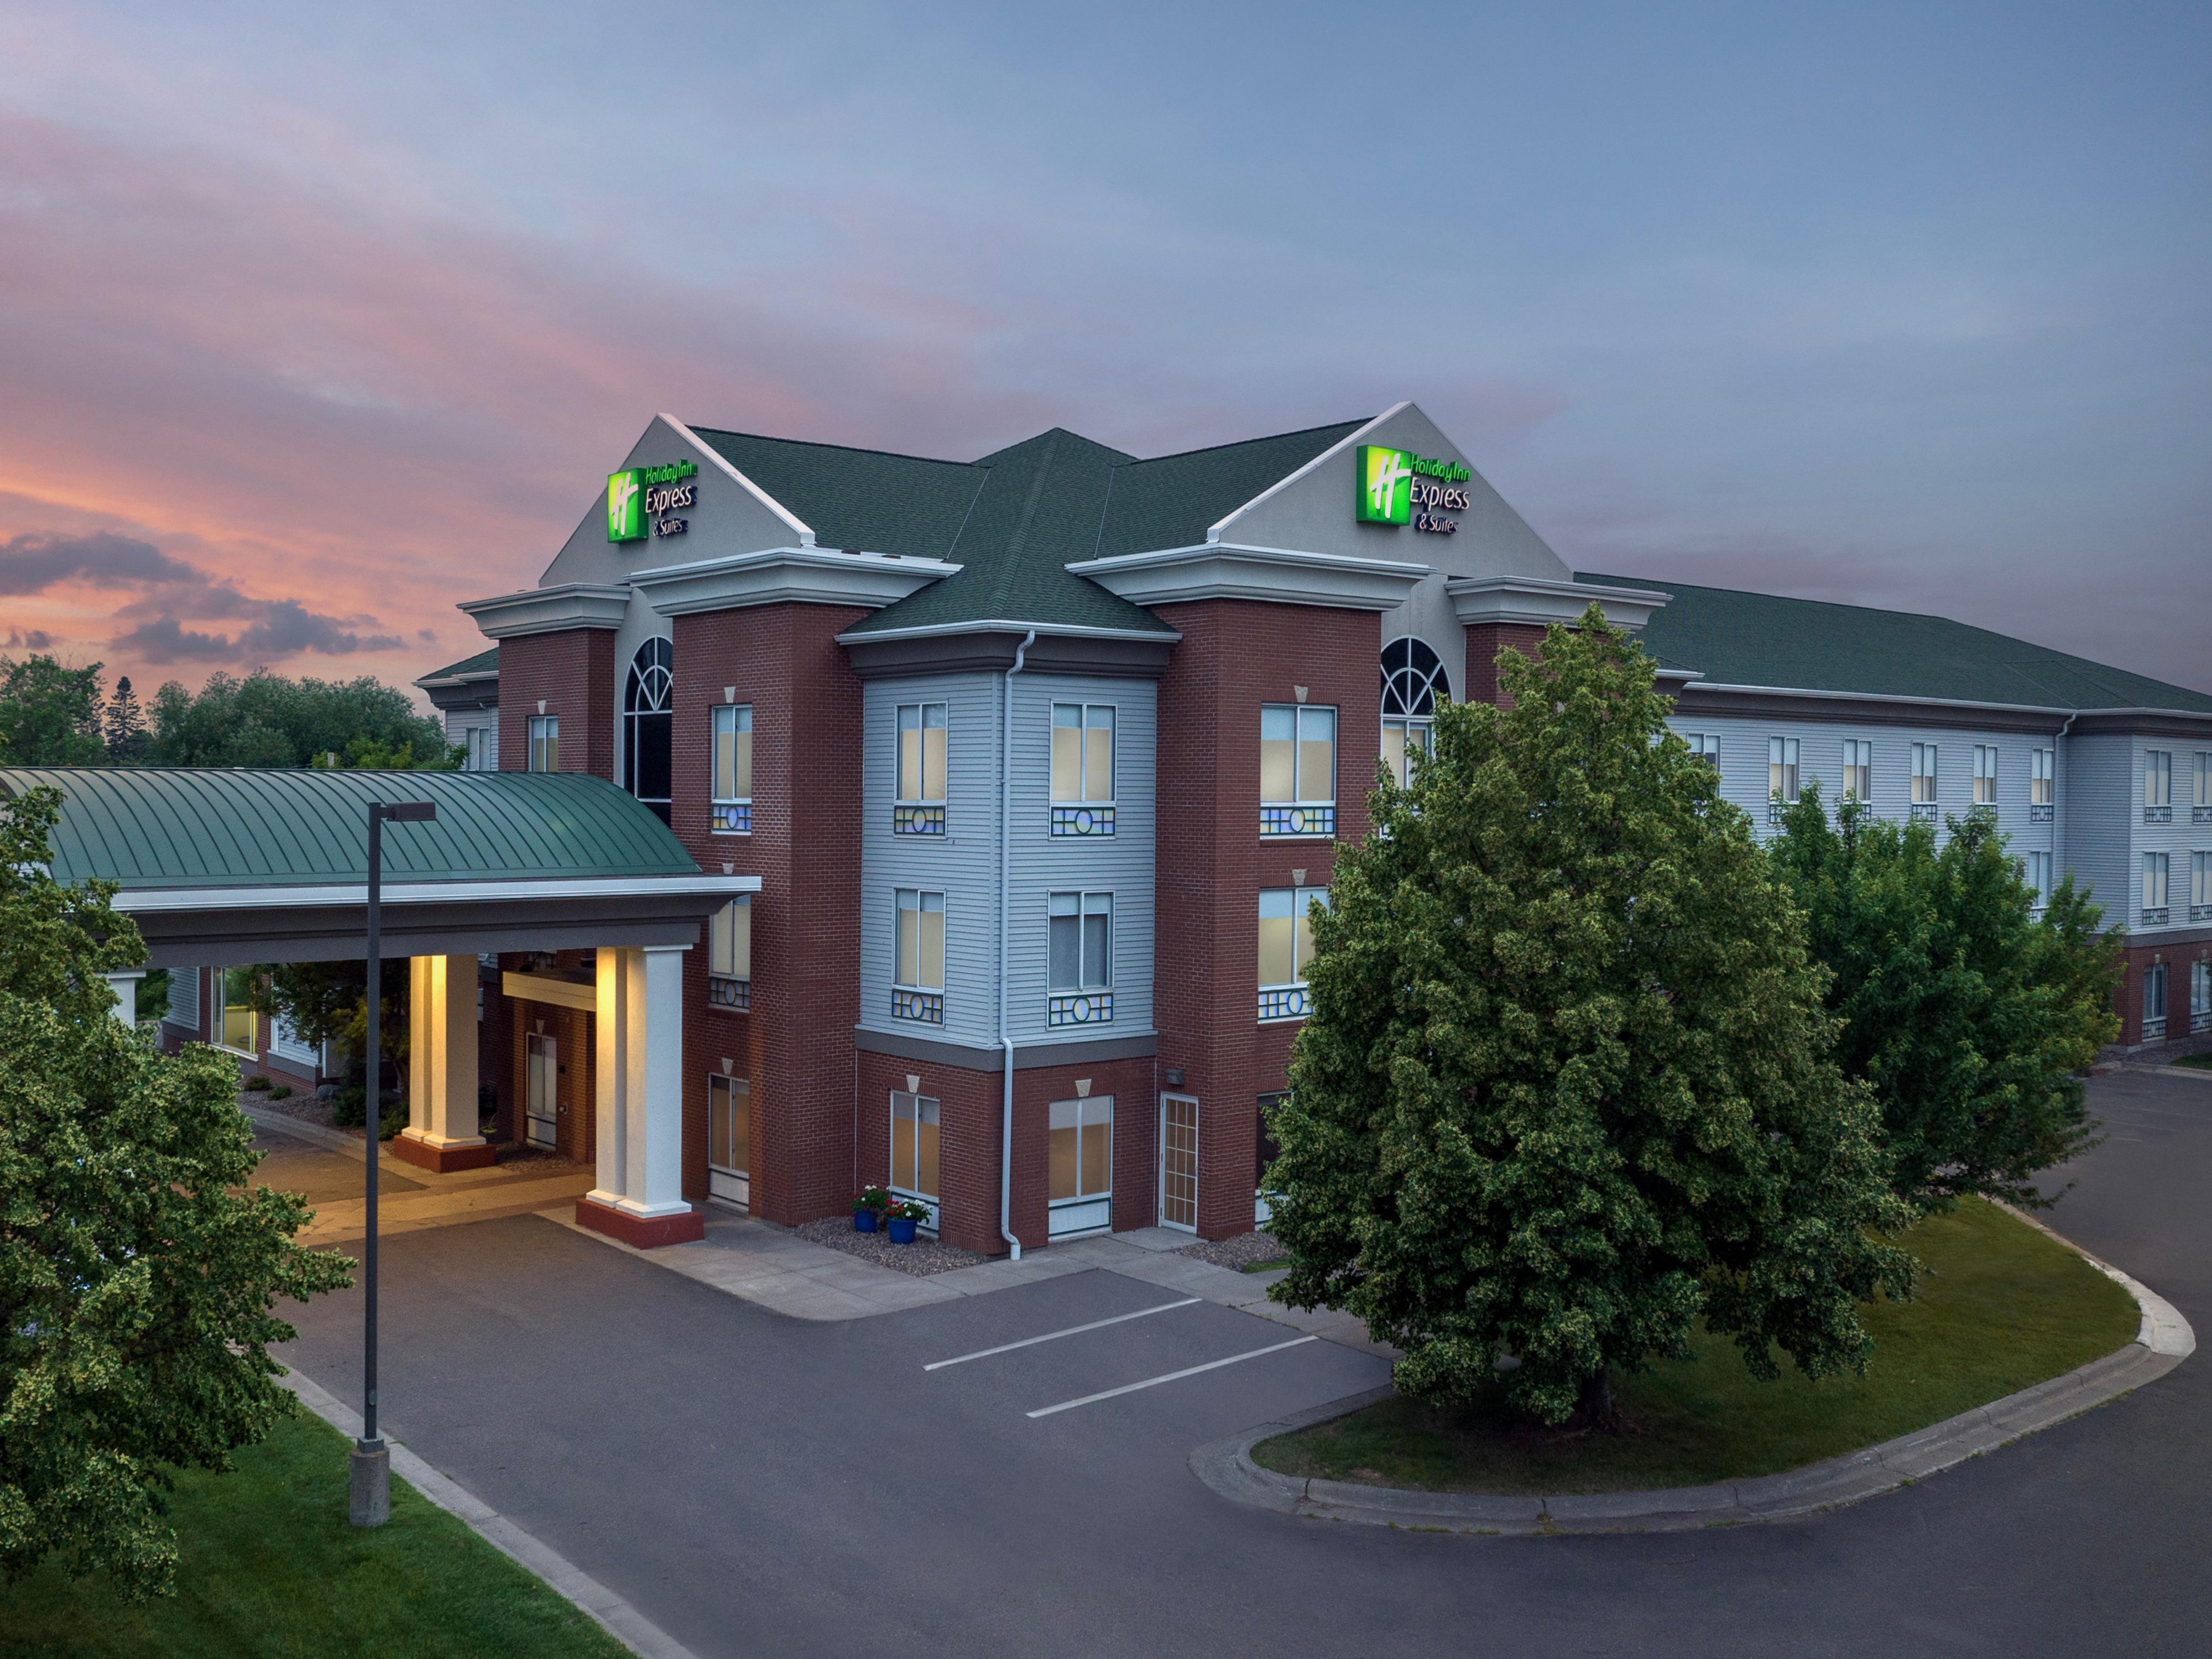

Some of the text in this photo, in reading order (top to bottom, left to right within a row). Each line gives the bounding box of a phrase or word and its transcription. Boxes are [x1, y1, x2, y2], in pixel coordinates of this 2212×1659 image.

[645, 460, 692, 484] Holiday Inn
[1411, 453, 1471, 483] Holiday Inn
[645, 486, 692, 517] Express
[1410, 476, 1470, 512] Express
[660, 519, 682, 536] Suites
[1419, 513, 1458, 534] & Suites
